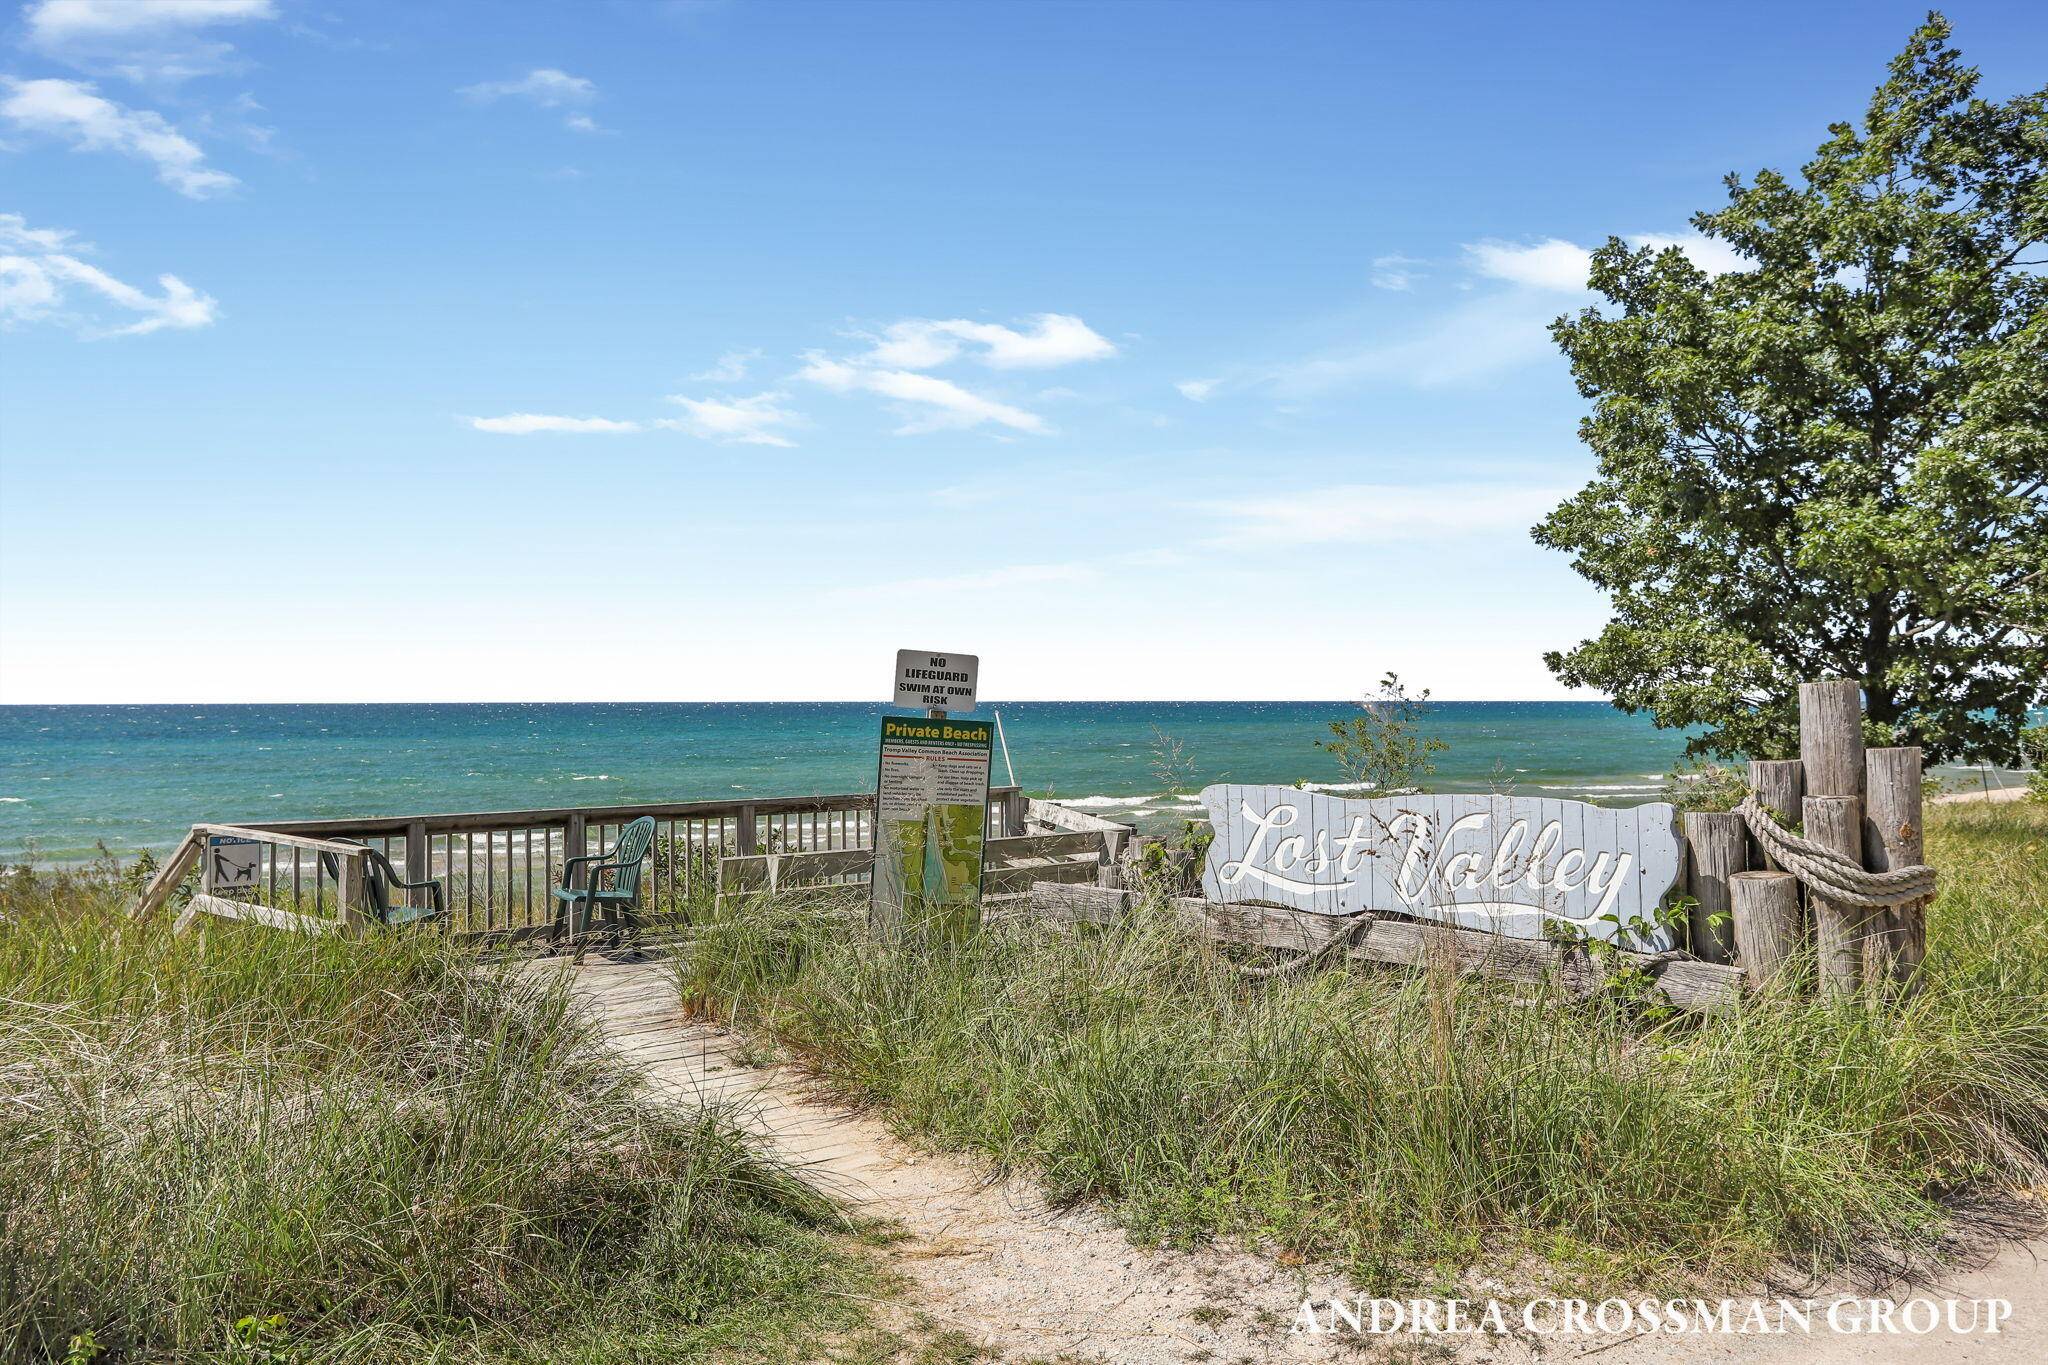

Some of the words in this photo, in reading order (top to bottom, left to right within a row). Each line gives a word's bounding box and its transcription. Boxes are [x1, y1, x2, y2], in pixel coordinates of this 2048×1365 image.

[929, 657, 947, 668] NO
[905, 668, 969, 682] LIFEGUARD
[899, 682, 931, 693] SWIM
[932, 685, 945, 694] AT
[947, 686, 972, 696] OWN
[922, 695, 948, 705] RISK
[885, 723, 940, 738] Private
[943, 726, 988, 740] Beach
[1219, 798, 1374, 895] Lost
[1386, 810, 1633, 926] Valley
